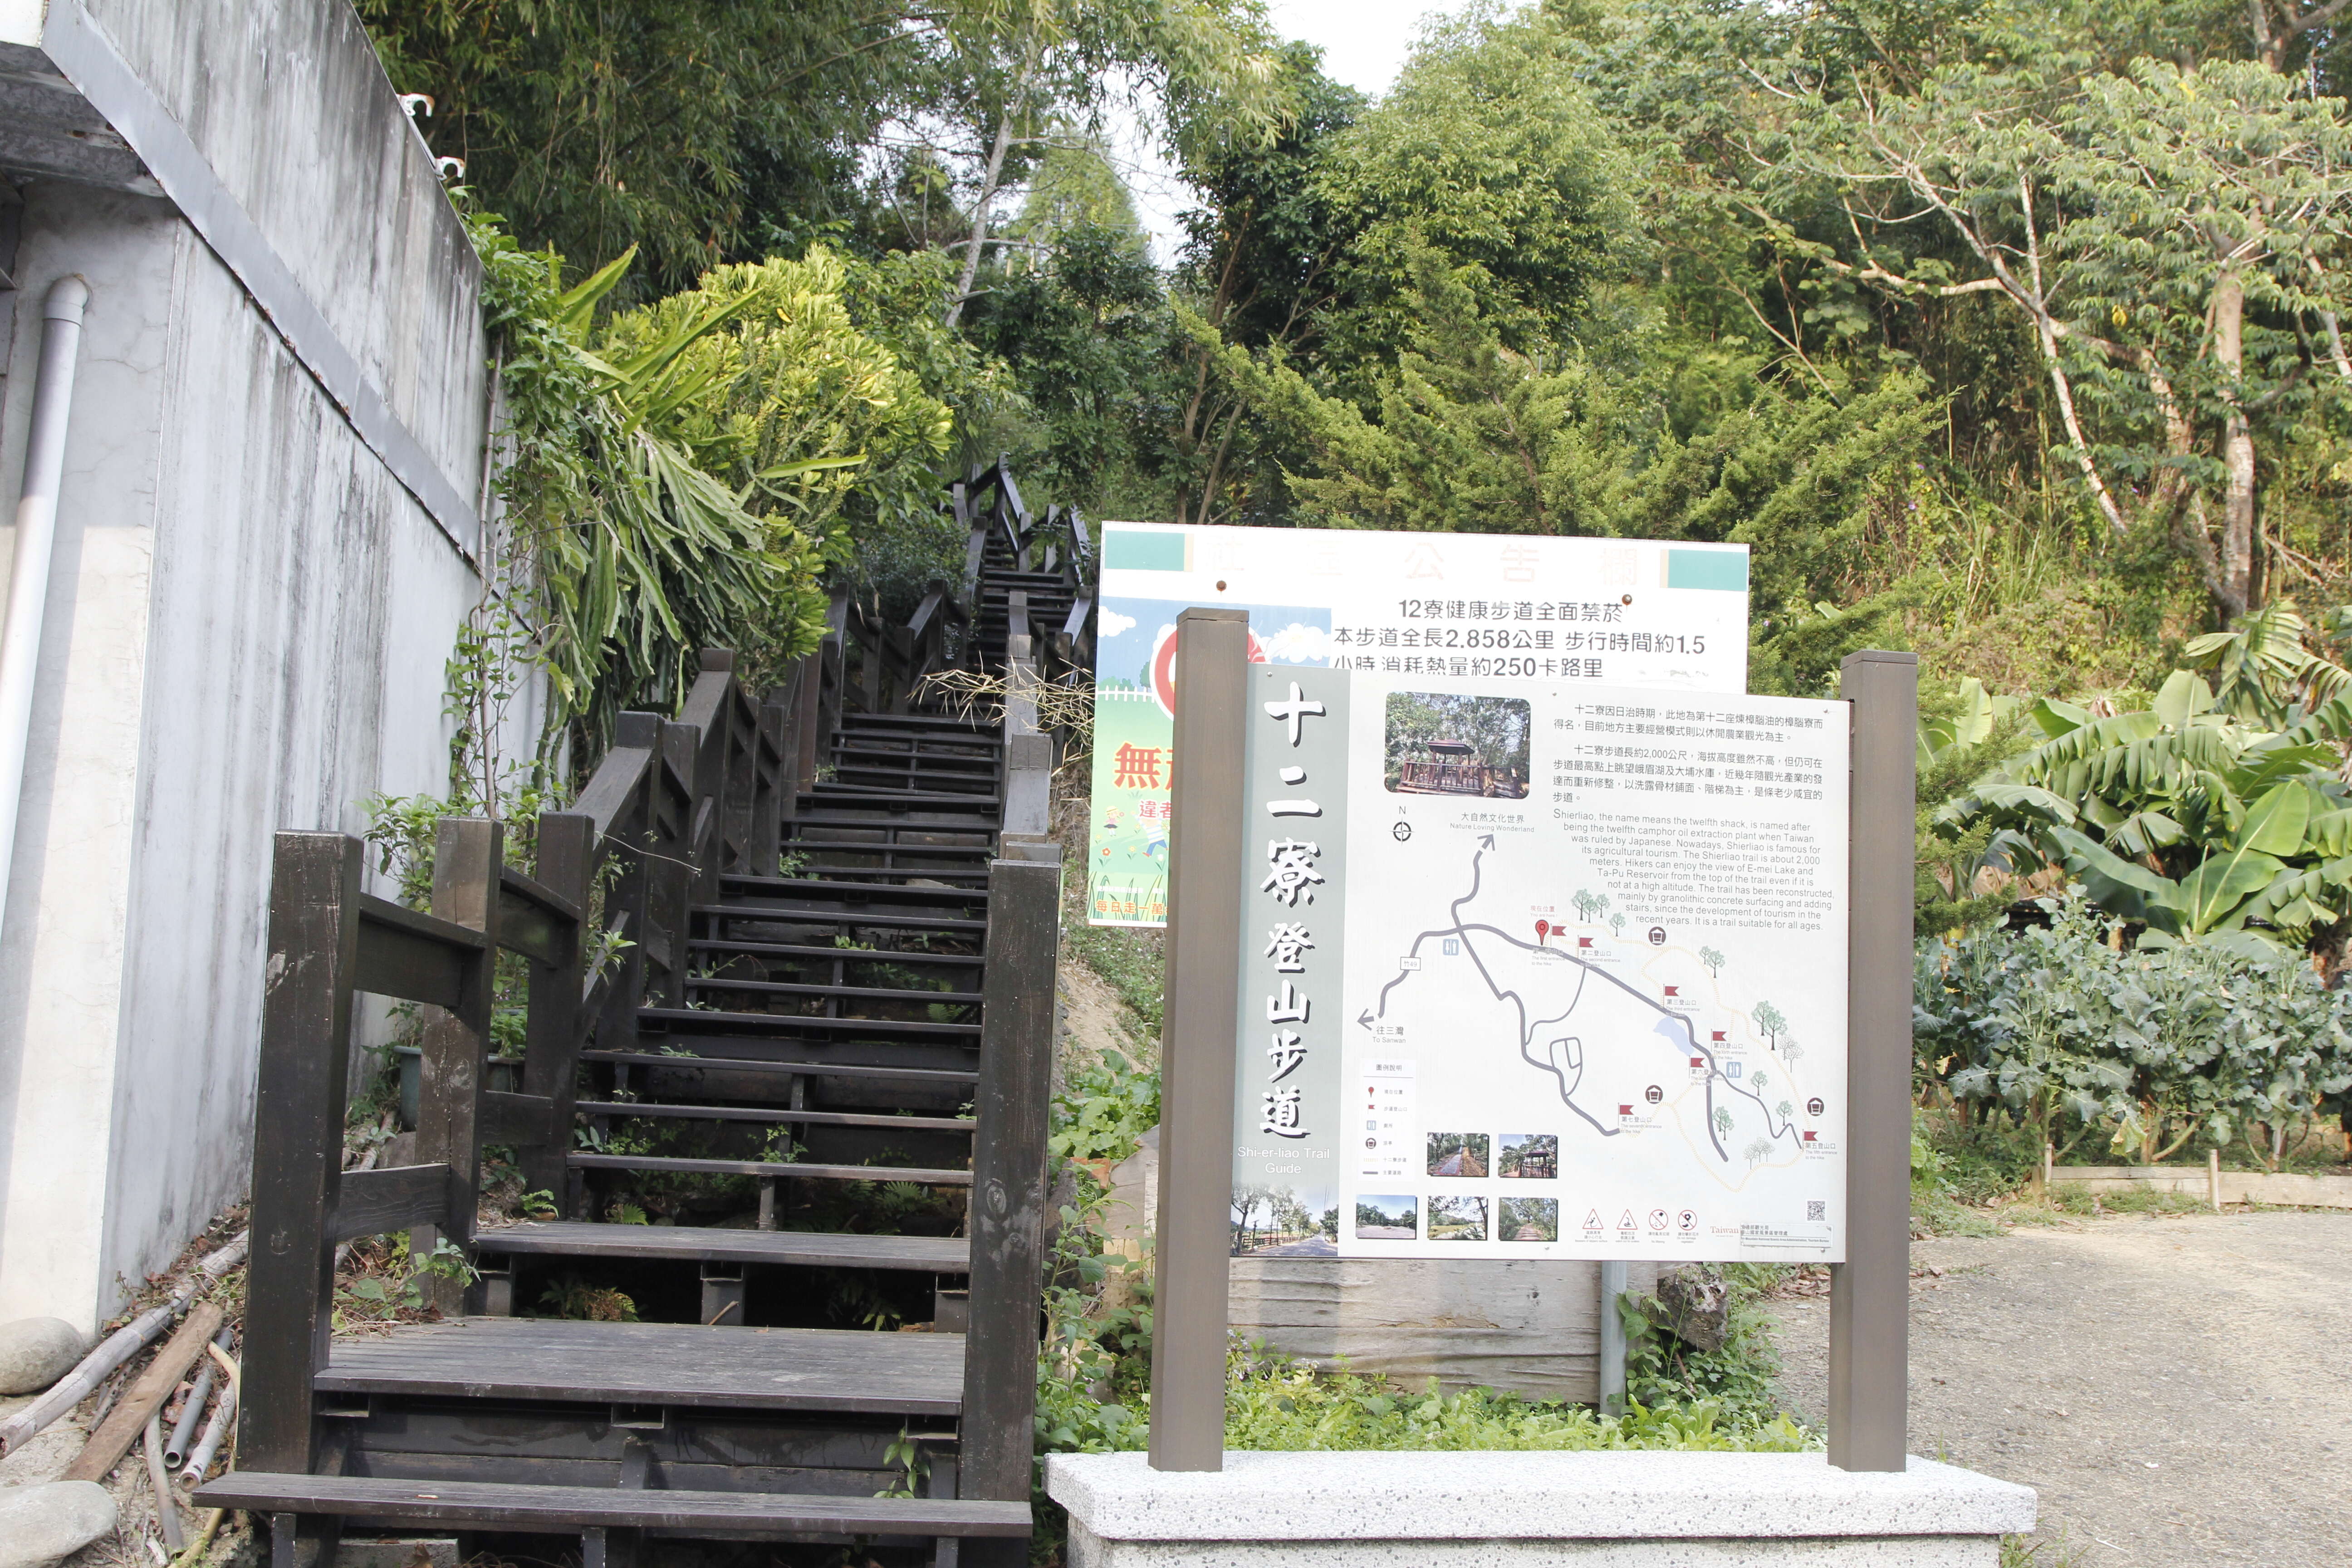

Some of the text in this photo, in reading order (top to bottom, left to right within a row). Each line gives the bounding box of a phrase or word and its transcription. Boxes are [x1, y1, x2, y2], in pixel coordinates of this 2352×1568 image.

[1399, 599, 1622, 622] 12寮健康步道全面禁菸
[1334, 627, 1705, 654] 本步道全長2.858公里 步行時間約1.5
[1114, 742, 1173, 790] 無
[1553, 791, 1580, 803] 步道。
[1399, 806, 1406, 814] N
[1461, 812, 1525, 823] 大自然文化世界
[1553, 808, 1596, 821] Shierliao,
[1599, 812, 1613, 821] the
[1642, 816, 1671, 824] means
[1674, 816, 1687, 825] the
[1690, 817, 1718, 826] twelfth
[1720, 819, 1748, 829] shack,
[1750, 820, 1758, 829] is
[1760, 822, 1788, 830] named
[1791, 822, 1811, 831] after
[1473, 823, 1494, 832] Loving
[1563, 822, 1814, 843] being the twelfth camphor oil extraction plant when Taiwan
[1591, 835, 1613, 844] ruled
[1616, 836, 1627, 846] by
[1628, 837, 1673, 847] Japanese.
[1676, 838, 1724, 851] Nowadays,
[1726, 841, 1764, 851] Shierliao
[1767, 843, 1774, 852] is
[1776, 843, 1807, 853] famous
[1809, 845, 1821, 854] for
[1582, 845, 1820, 865] its agricultural tourism. The Shierliao trail is about 2,000
[1589, 858, 1622, 866] meters.
[1625, 858, 1653, 868] Hikers
[1673, 862, 1697, 872] enjoy
[1699, 862, 1713, 871] the
[1715, 863, 1735, 872] view
[1736, 863, 1745, 872] of
[1747, 864, 1772, 873] E-mei
[1774, 865, 1795, 875] Lake
[1797, 867, 1813, 875] and
[1597, 867, 1624, 877] Ta-Pu
[1627, 869, 1669, 879] Reservoir
[1671, 871, 1690, 880] from
[1693, 872, 1706, 882] the
[1709, 874, 1722, 884] top
[1725, 874, 1734, 882] of
[1735, 874, 1749, 883] the
[1751, 876, 1767, 884] trail
[1792, 877, 1798, 885] if
[1799, 877, 1804, 886] it
[1807, 878, 1814, 887] is
[1607, 880, 1621, 889] not
[1623, 881, 1632, 889] at
[1642, 881, 1660, 892] high
[1662, 882, 1695, 892] altitude.
[1698, 883, 1715, 893] The
[1717, 885, 1733, 893] trail
[1735, 885, 1750, 895] has
[1753, 886, 1774, 895] been
[1776, 889, 1834, 899] reconstructed,
[1096, 900, 1169, 915] 每日走一萬
[1259, 681, 1326, 1138] 十二寮登山步道
[1618, 892, 1832, 911] mainly by granolithic concrete surfacing and adding
[1626, 903, 1652, 913] stairs,
[1680, 905, 1694, 914] the
[1696, 906, 1751, 917] development
[1754, 908, 1762, 916] of
[1764, 909, 1796, 918] tourism
[1798, 910, 1805, 918] in
[1808, 911, 1821, 919] the
[1636, 915, 1663, 924] recent
[1666, 917, 1692, 926] years.
[1695, 916, 1700, 925] It
[1703, 917, 1710, 926] is
[1720, 918, 1736, 926] trail
[1738, 919, 1772, 928] suitable
[1774, 920, 1786, 929] for
[1788, 921, 1798, 929] all
[1800, 923, 1823, 932] ages.
[1237, 1146, 1330, 1159] Shi-er-liao Trail
[1265, 1162, 1302, 1174] Guide
